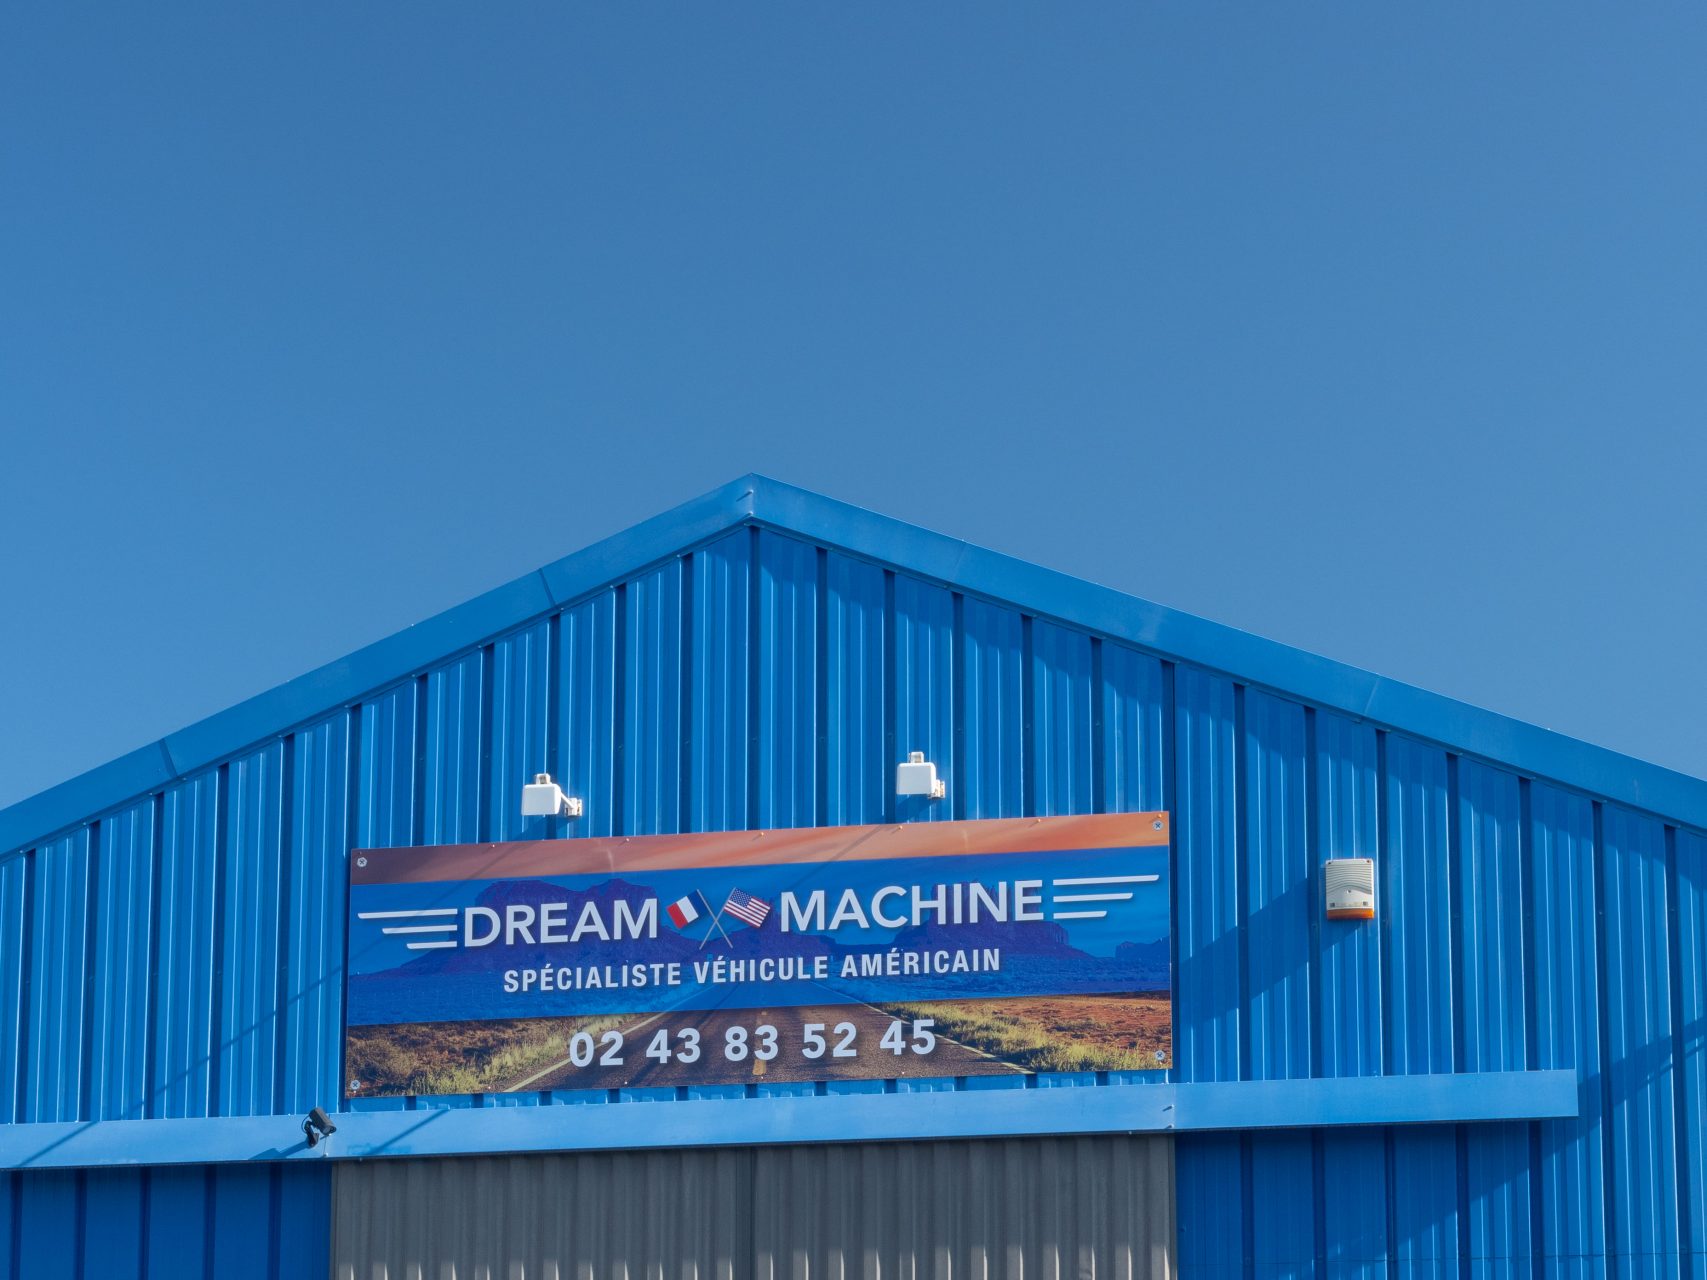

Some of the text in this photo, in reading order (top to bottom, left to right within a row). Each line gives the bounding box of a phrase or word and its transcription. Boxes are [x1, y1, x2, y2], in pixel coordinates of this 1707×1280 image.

[464, 879, 1044, 948] DREAM MACHINE
[503, 947, 1000, 993] SPÉCIALISTE VÉHICULE AMÉRICAIN
[569, 1019, 936, 1068] 02 43 83 52 45
